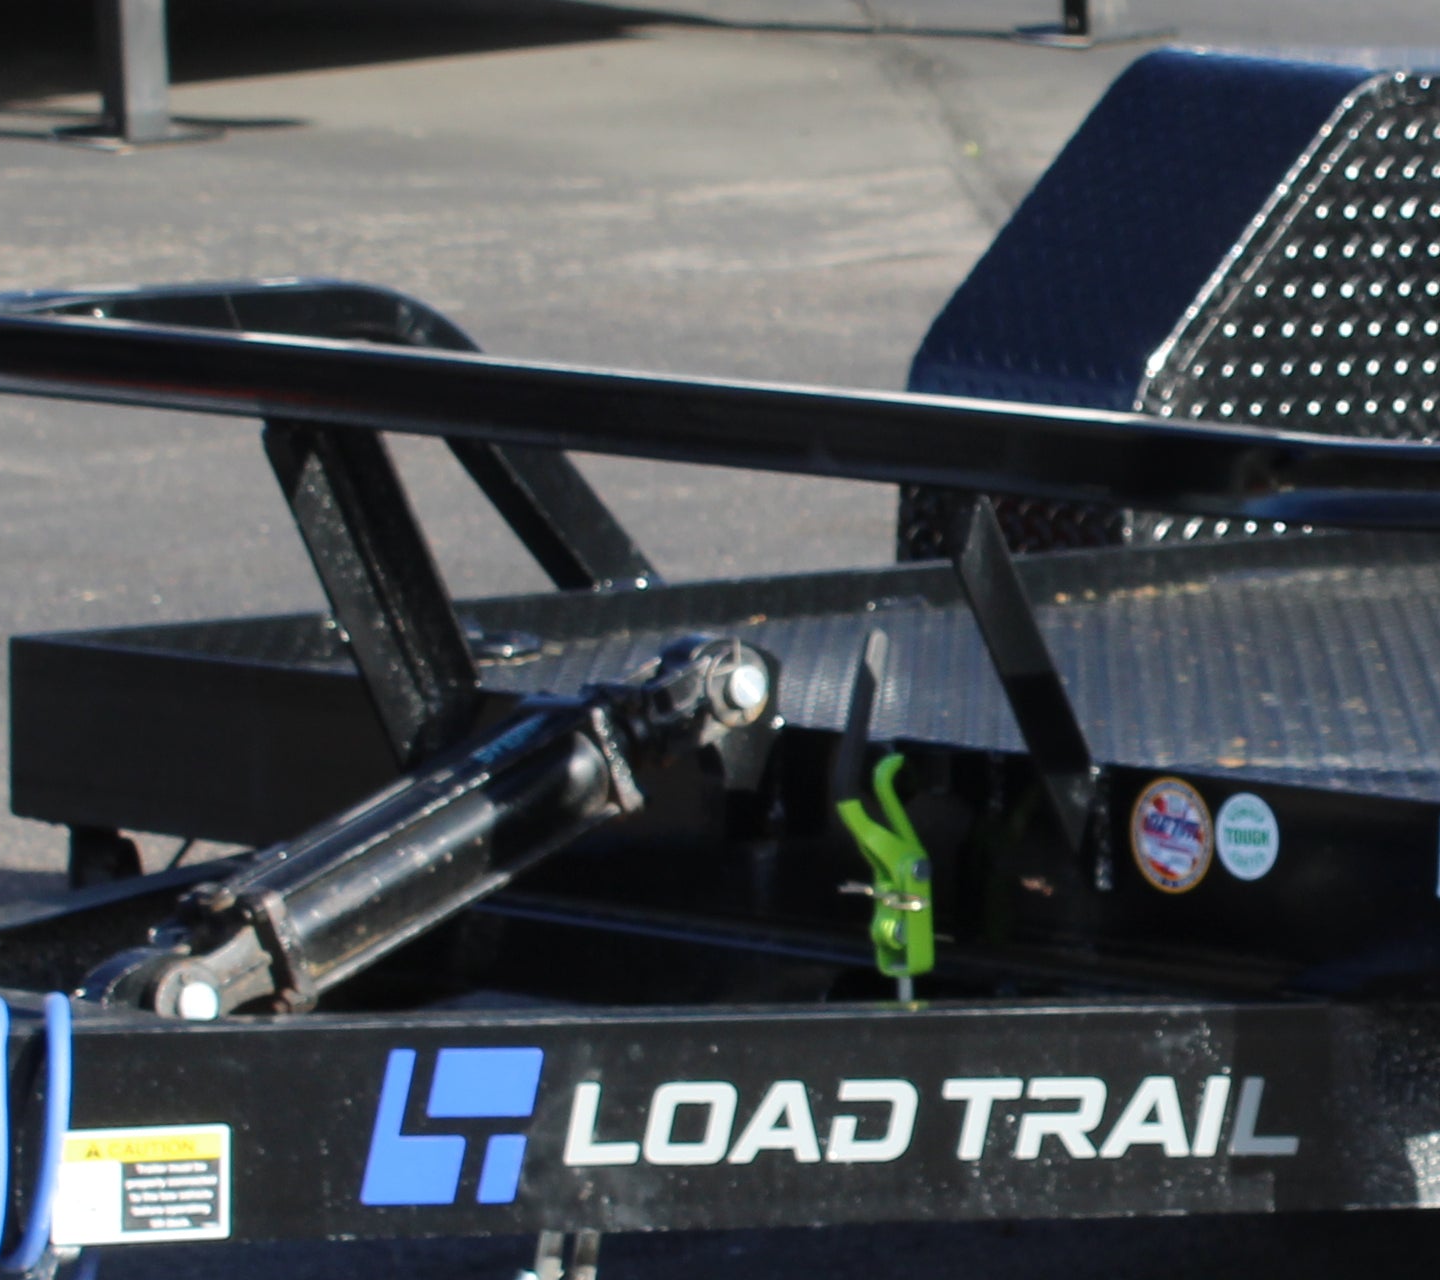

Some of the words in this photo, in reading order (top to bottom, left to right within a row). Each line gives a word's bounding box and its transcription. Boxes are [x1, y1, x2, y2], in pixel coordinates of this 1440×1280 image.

[109, 1139, 195, 1157] CAUTION
[563, 1078, 919, 1167] LOAD
[943, 1075, 1300, 1161] TRAIL
